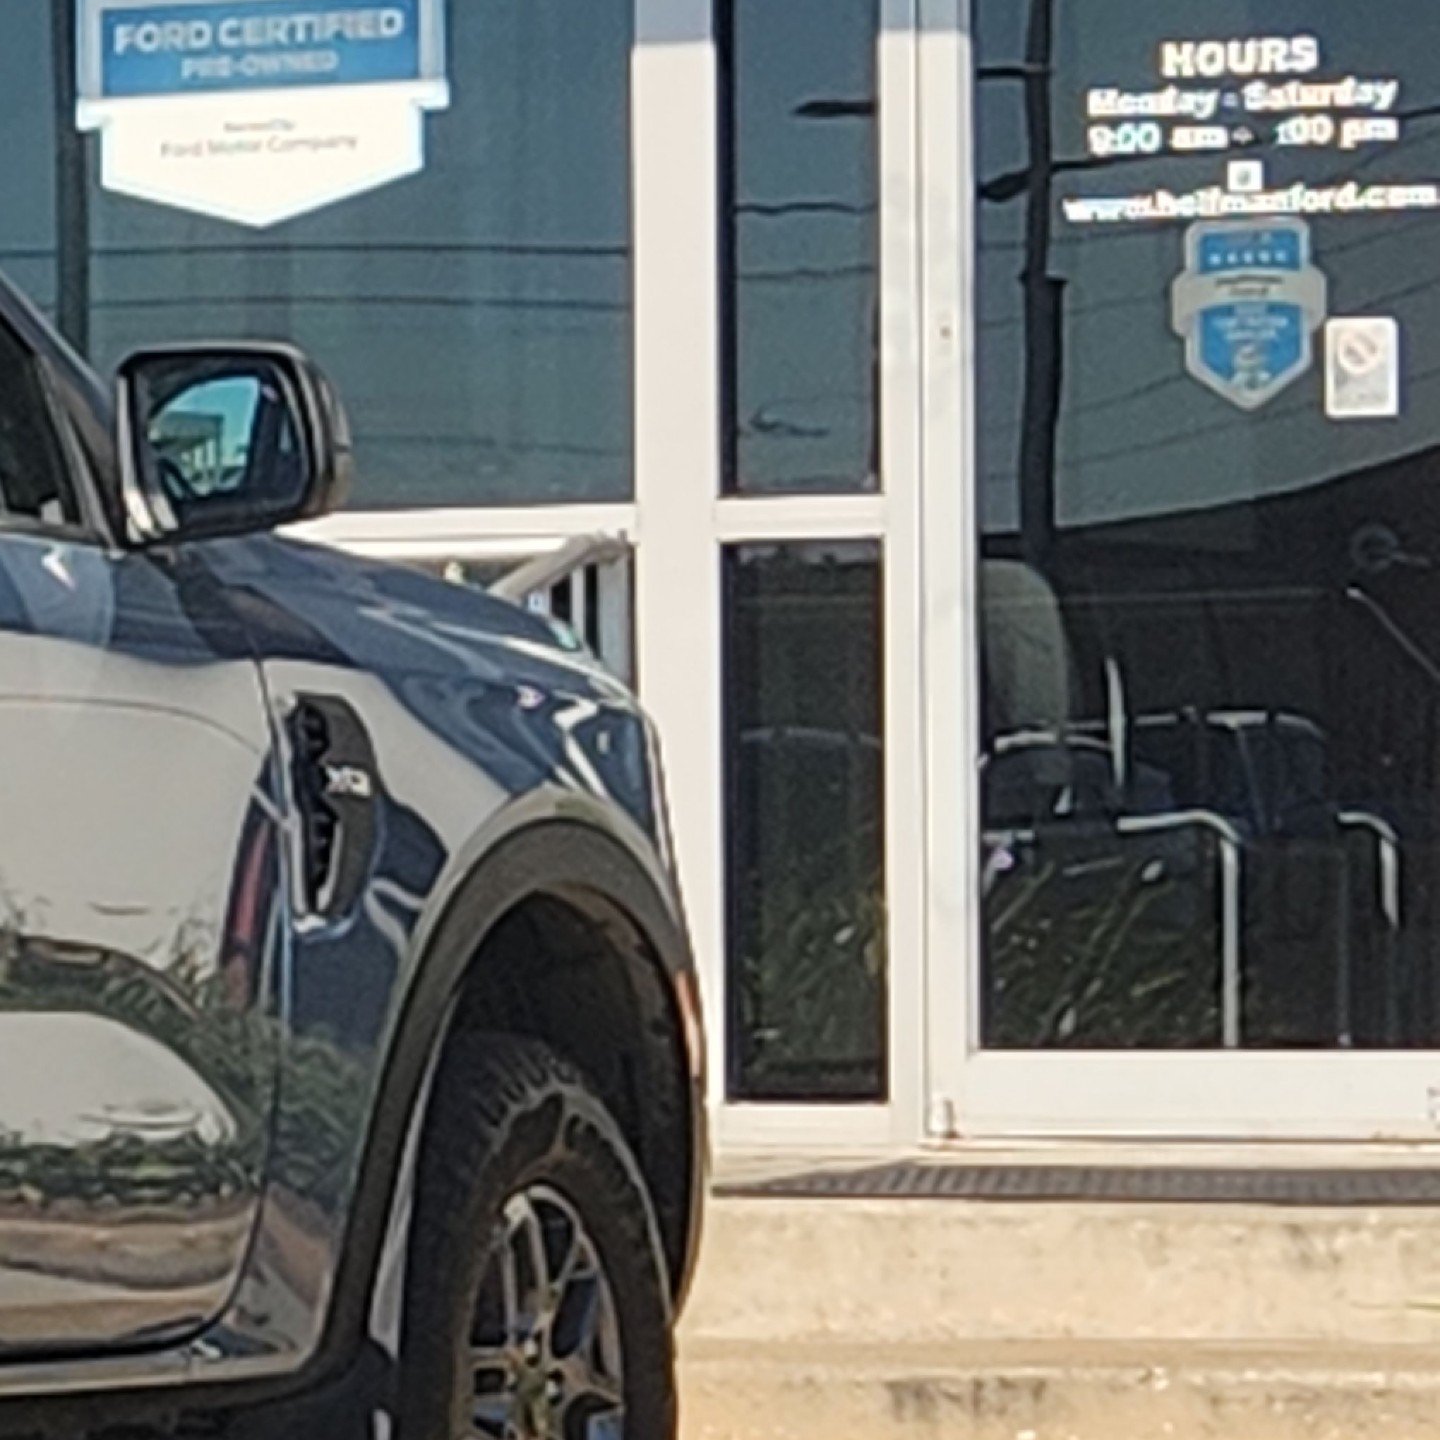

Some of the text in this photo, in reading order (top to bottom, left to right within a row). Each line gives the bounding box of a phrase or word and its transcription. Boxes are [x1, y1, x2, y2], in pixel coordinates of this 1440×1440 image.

[113, 8, 406, 55] FORD CERTIFIED
[182, 49, 340, 80] PRE-OWNED
[1159, 34, 1319, 78] HOURS
[1086, 84, 1220, 120] Monday
[1241, 75, 1399, 111] Saturday
[160, 132, 358, 158] Ford Motor Company
[1169, 125, 1229, 149] am
[1338, 116, 1399, 149] pm
